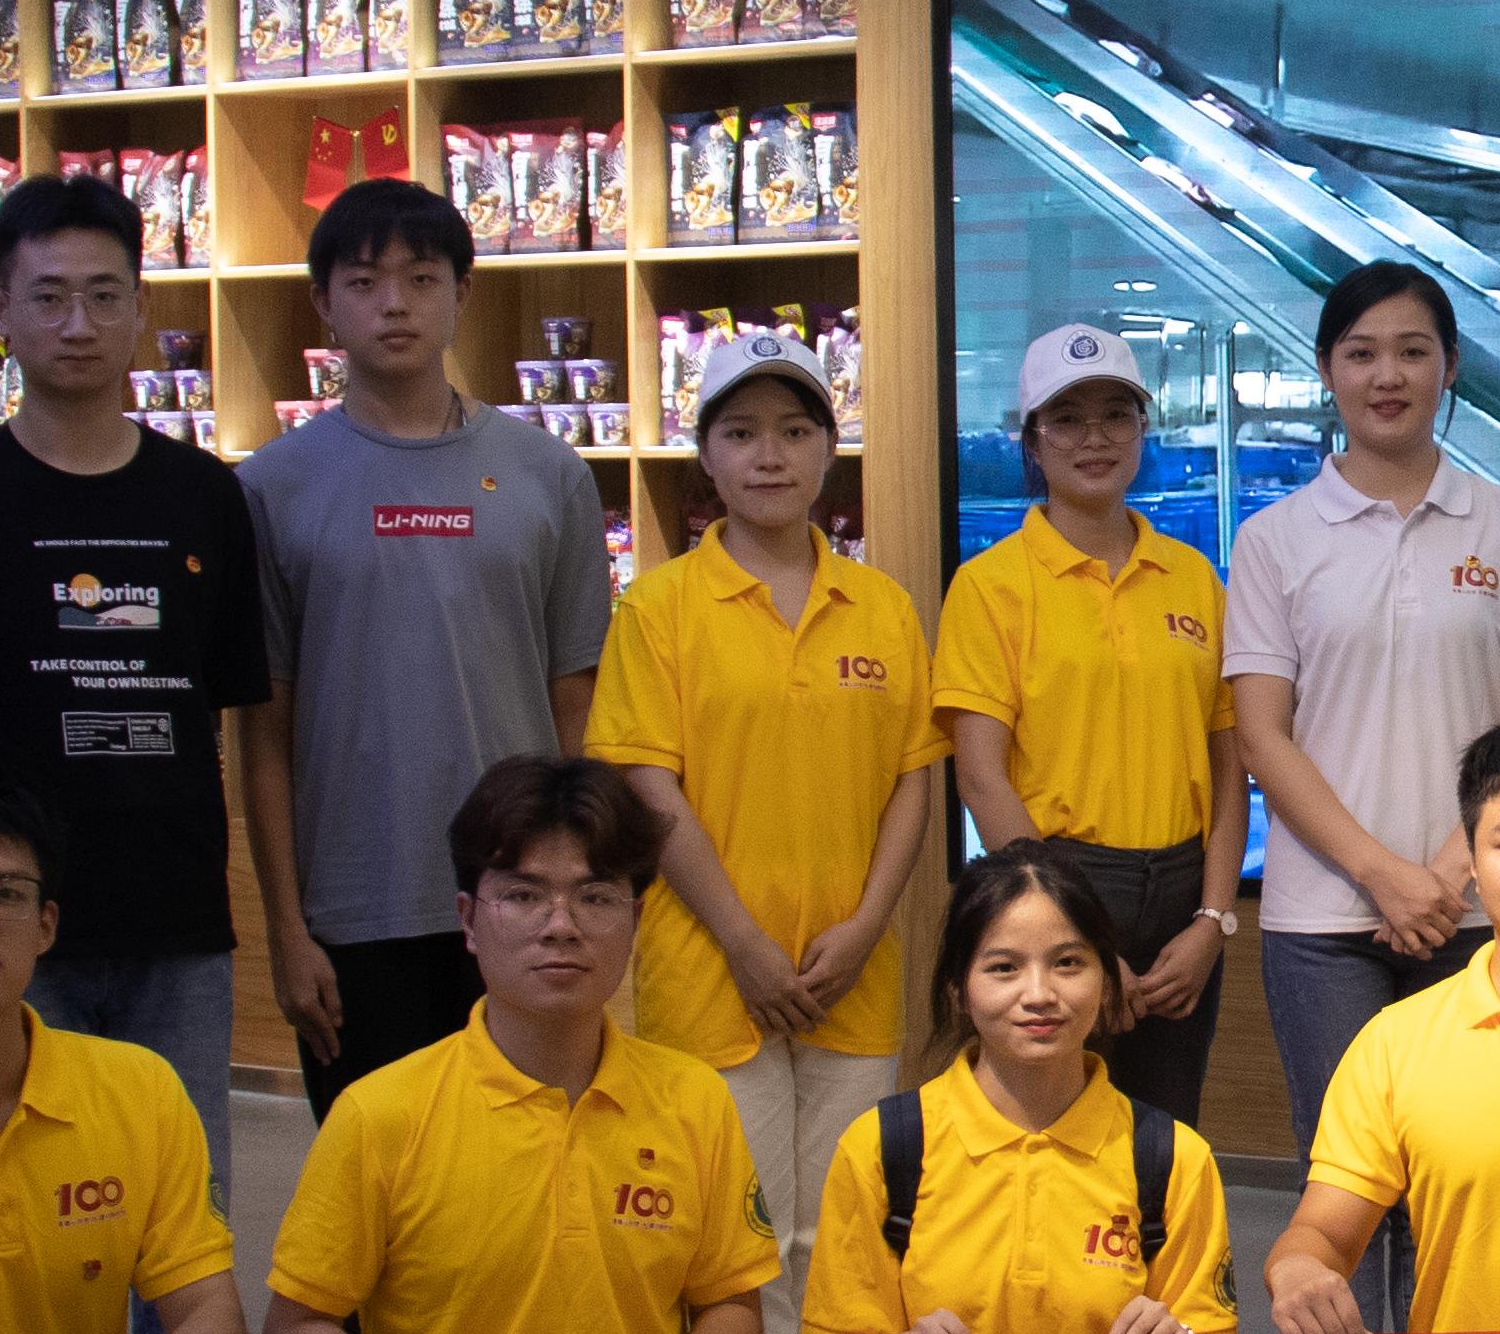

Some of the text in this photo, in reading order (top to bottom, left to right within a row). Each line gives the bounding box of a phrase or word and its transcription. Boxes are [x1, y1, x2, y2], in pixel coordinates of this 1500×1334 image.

[375, 512, 472, 530] LI-NING
[53, 582, 160, 607] Exploring
[30, 659, 146, 671] TAKE CONTROL OF
[837, 655, 887, 682] 100
[72, 676, 106, 688] YOUR
[107, 676, 140, 689] OWN
[55, 1175, 125, 1215] 100
[614, 1183, 674, 1220] 100
[1084, 1223, 1140, 1262] 100
